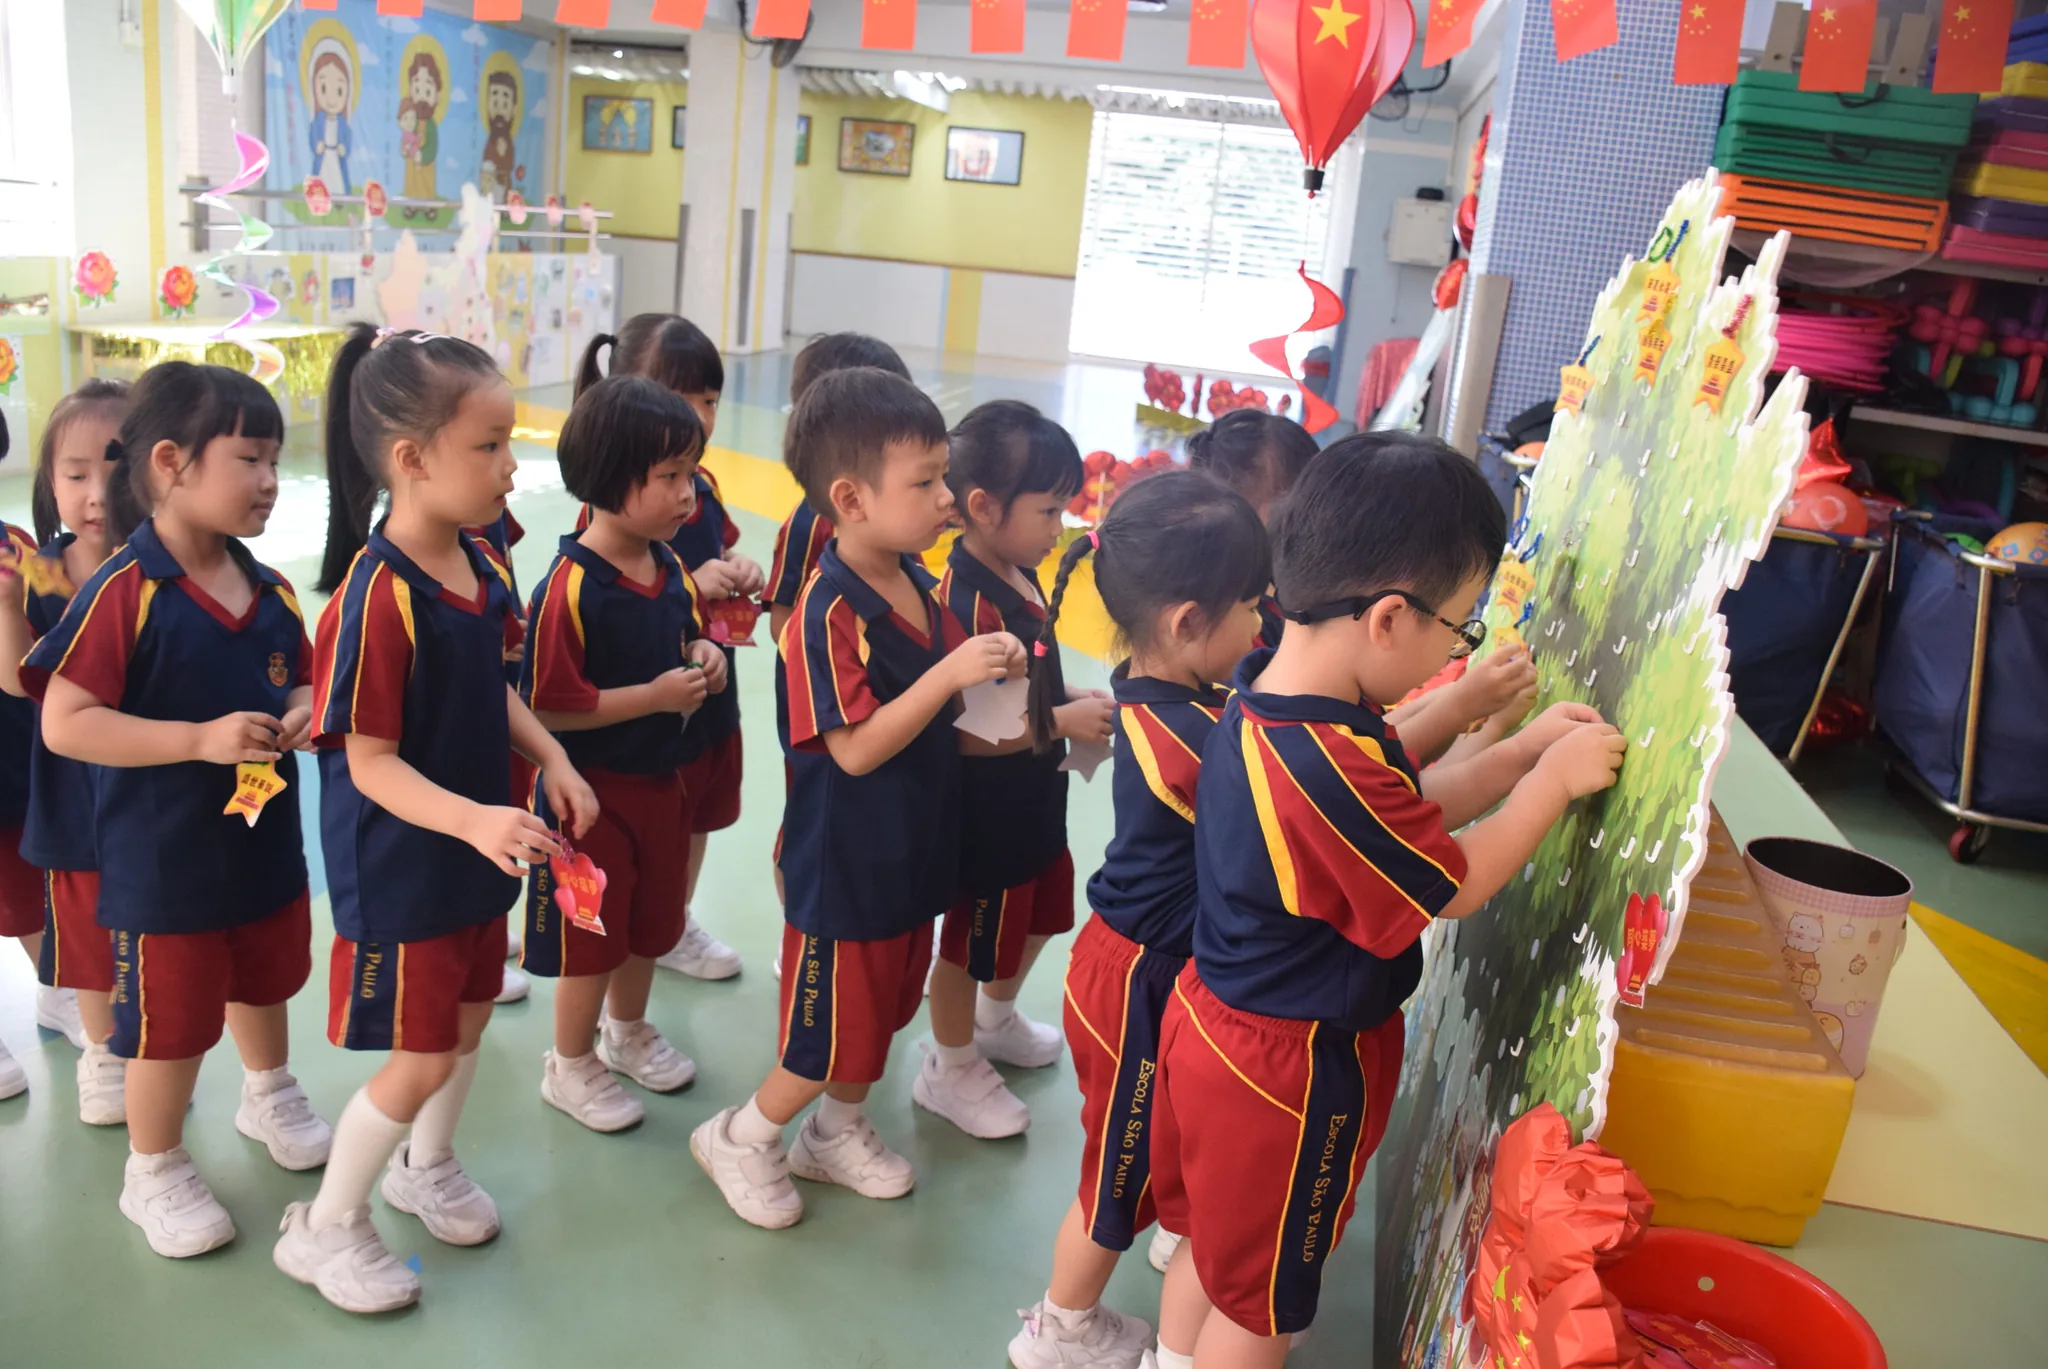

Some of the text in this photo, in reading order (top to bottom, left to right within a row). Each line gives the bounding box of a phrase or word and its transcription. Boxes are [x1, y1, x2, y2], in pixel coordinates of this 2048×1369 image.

[360, 952, 383, 999] PAULO
[803, 988, 819, 1027] PAULO
[1112, 1058, 1156, 1199] ESCOLA SÃO PAULO
[1302, 1113, 1348, 1263] ESCOLA SÃO PAULO
